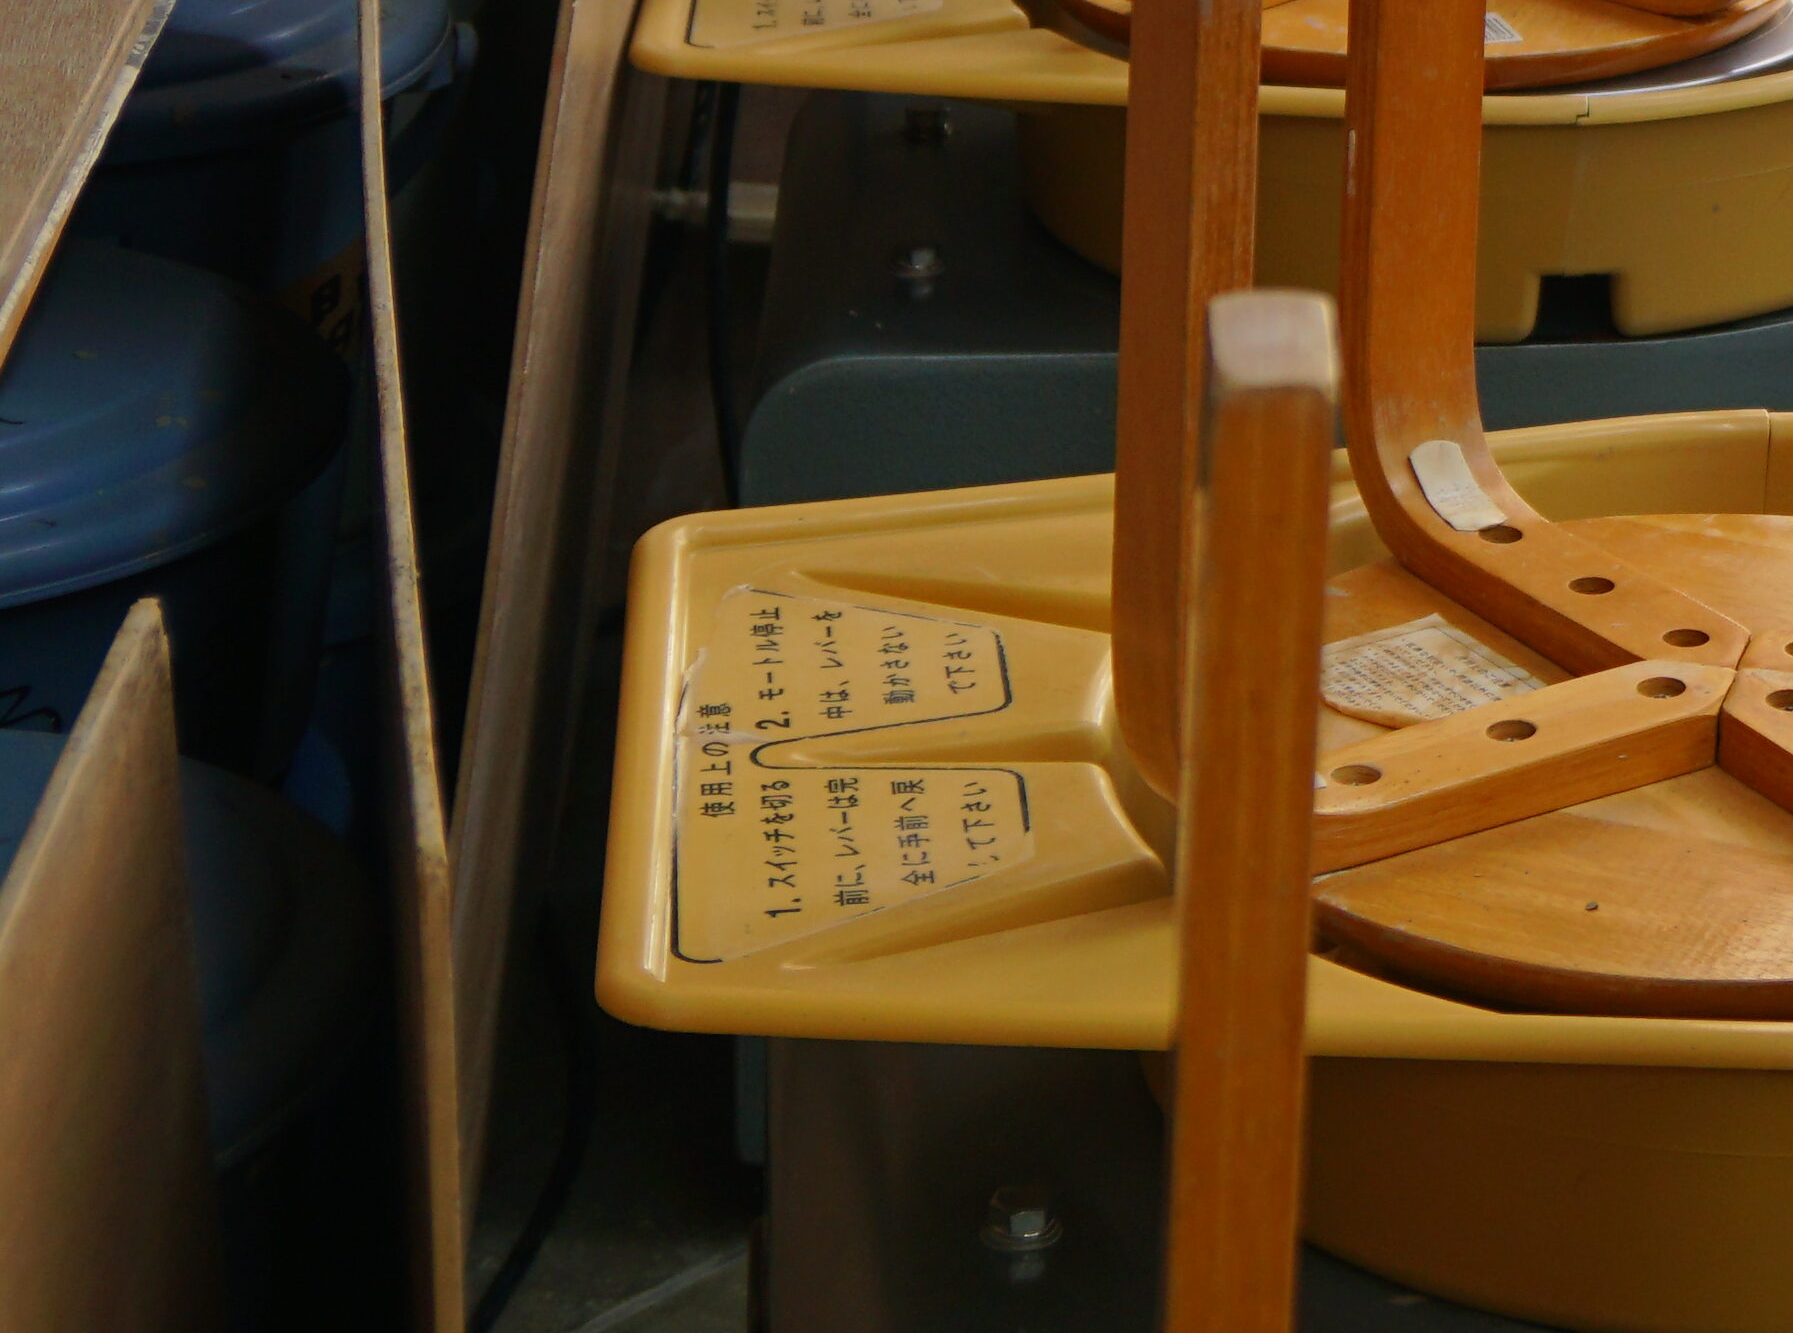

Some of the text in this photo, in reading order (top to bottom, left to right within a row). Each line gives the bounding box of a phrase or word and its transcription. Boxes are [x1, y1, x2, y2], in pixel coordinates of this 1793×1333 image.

[812, 608, 853, 719] 中は、レバーを
[880, 626, 916, 705] 動かさない
[945, 633, 977, 695] で下さい
[696, 702, 735, 817] 使用上の注意
[824, 776, 870, 906] 前に、レバーは完
[892, 779, 936, 887] 全に手前へ戻
